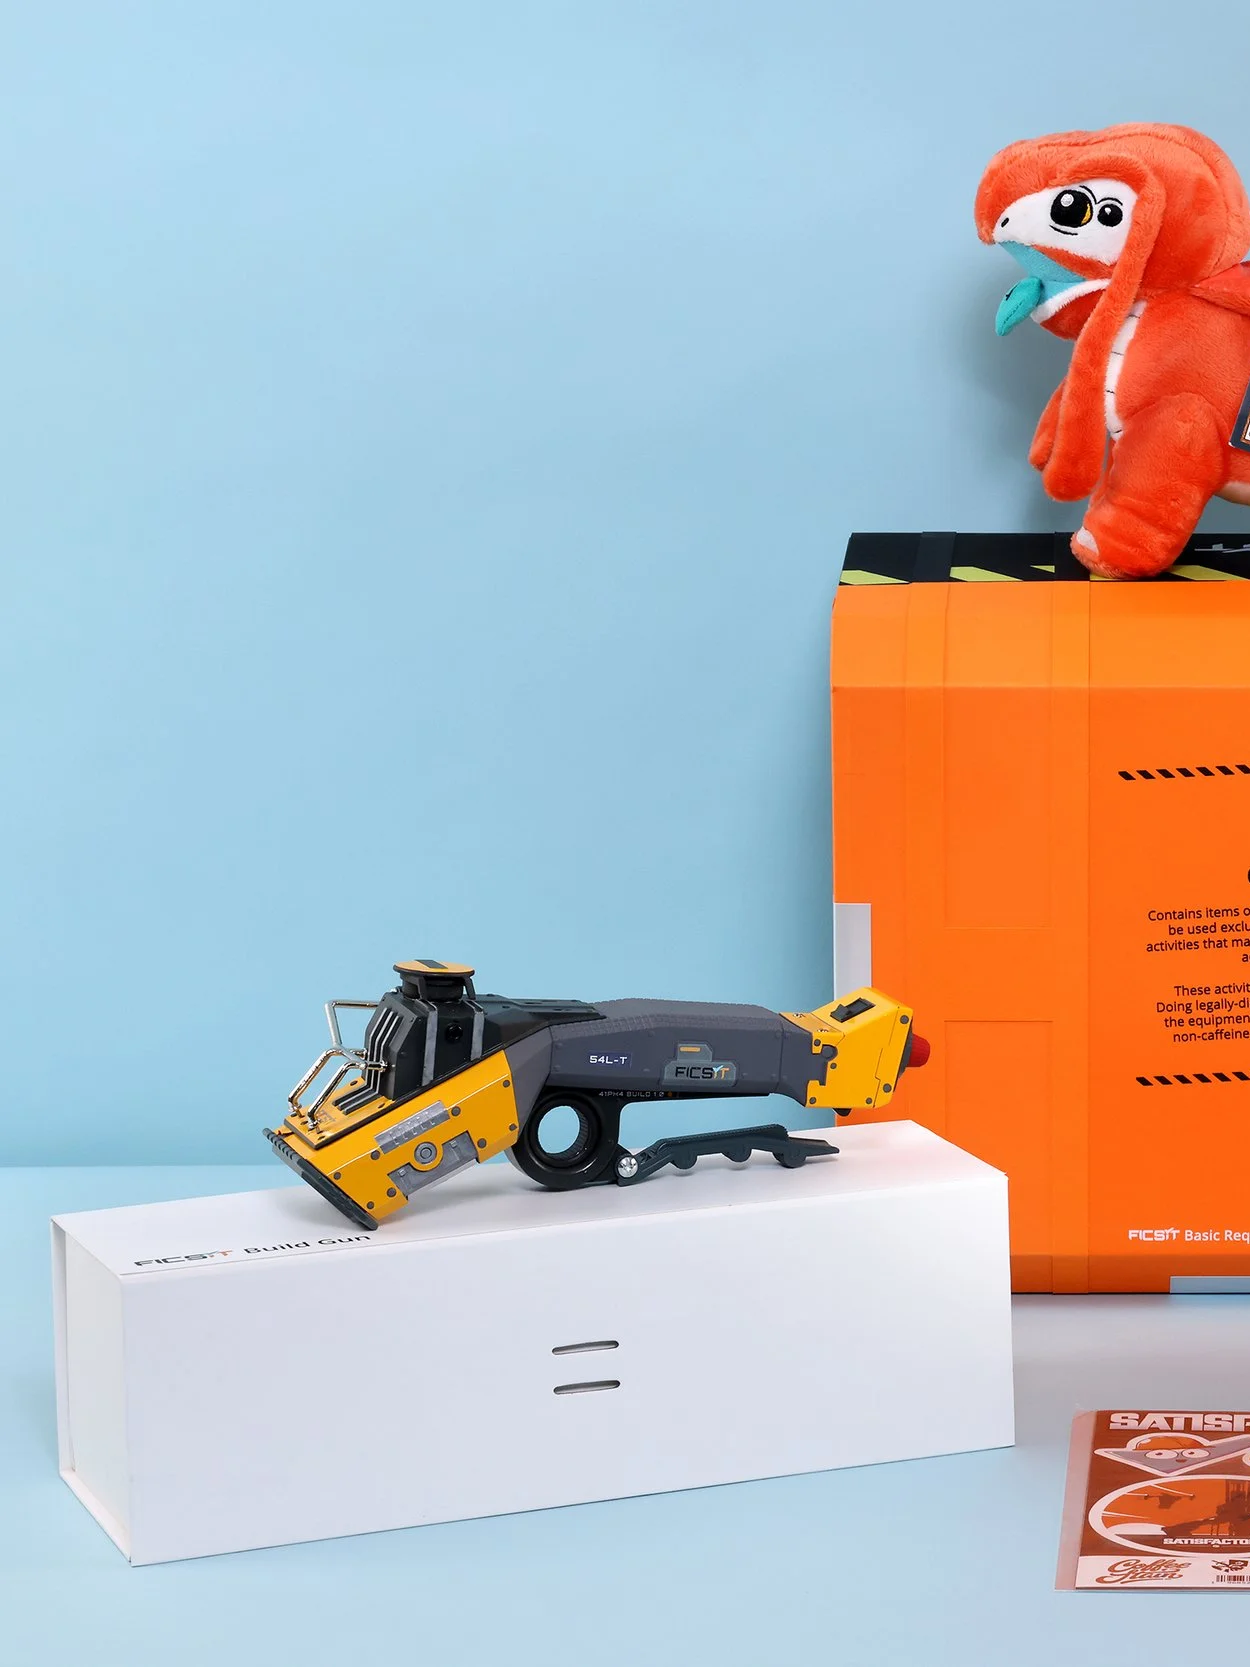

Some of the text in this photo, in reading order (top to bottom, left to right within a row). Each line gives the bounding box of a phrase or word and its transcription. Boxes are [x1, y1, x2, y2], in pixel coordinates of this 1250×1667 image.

[1148, 909, 1202, 921] Contains
[1206, 908, 1240, 918] items
[1168, 925, 1184, 936] be
[1188, 922, 1217, 934] used
[1146, 940, 1200, 952] activities
[1202, 938, 1228, 949] that
[1174, 985, 1211, 996] These
[1156, 1001, 1193, 1014] Doing
[1164, 1016, 1184, 1028] the
[1173, 1028, 1250, 1042] non-caffeine
[589, 1055, 628, 1065] 54L-T
[1184, 1229, 1220, 1241] Basic
[244, 1241, 311, 1254] Build
[318, 1235, 371, 1245] Gun
[1108, 1559, 1192, 1573] Coffee
